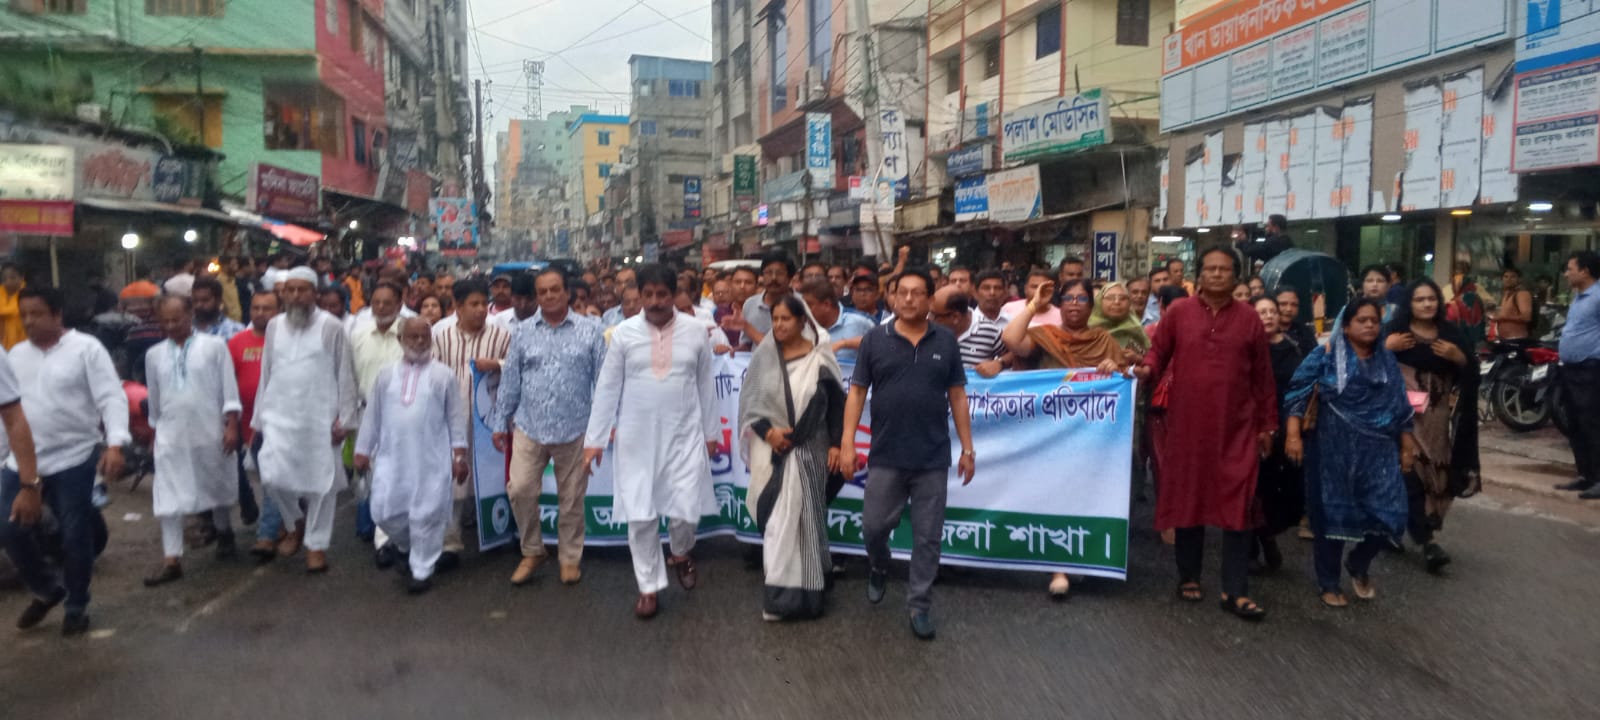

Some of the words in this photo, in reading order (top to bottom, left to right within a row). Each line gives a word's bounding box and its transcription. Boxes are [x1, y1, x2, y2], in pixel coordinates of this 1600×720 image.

[1004, 114, 1040, 145] পলাশ
[1042, 97, 1100, 138] মেডিসিন
[966, 391, 1036, 422] াশকতার
[1041, 385, 1119, 423] প্রতিবাদে
[1004, 522, 1091, 557] শাখা
